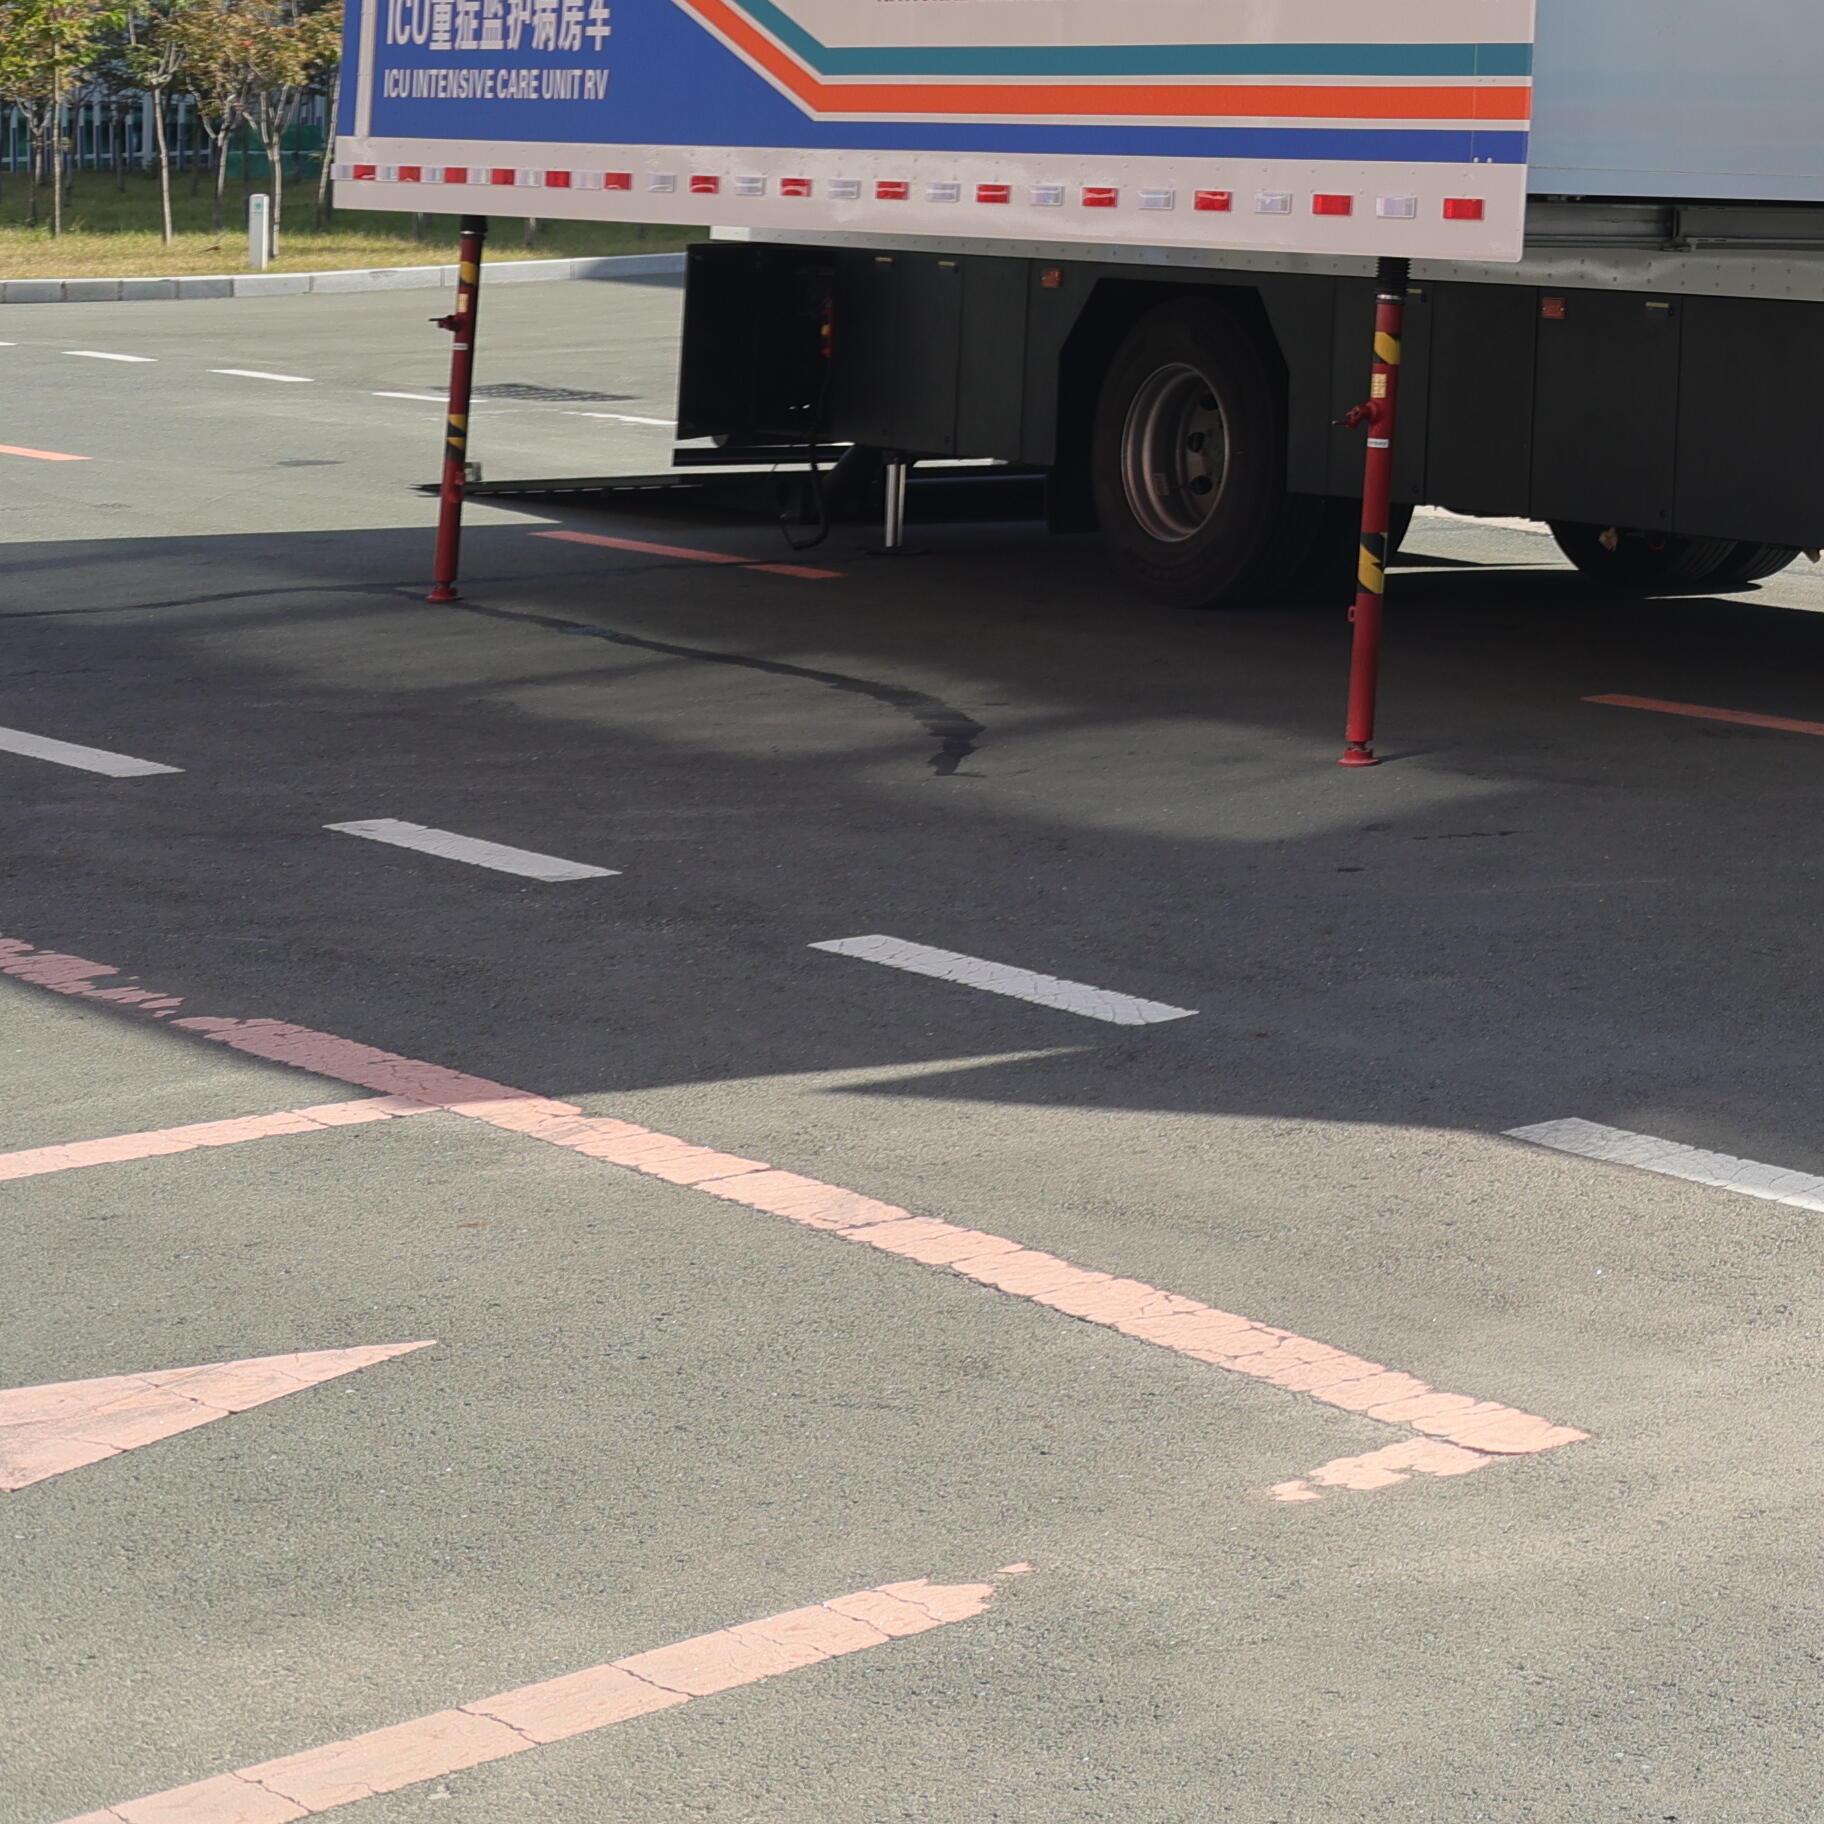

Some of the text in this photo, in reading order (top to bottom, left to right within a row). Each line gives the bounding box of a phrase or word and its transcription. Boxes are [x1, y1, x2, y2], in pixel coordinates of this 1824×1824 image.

[383, 69, 610, 100] ICU INTENSIVE CARE UNIT RV
